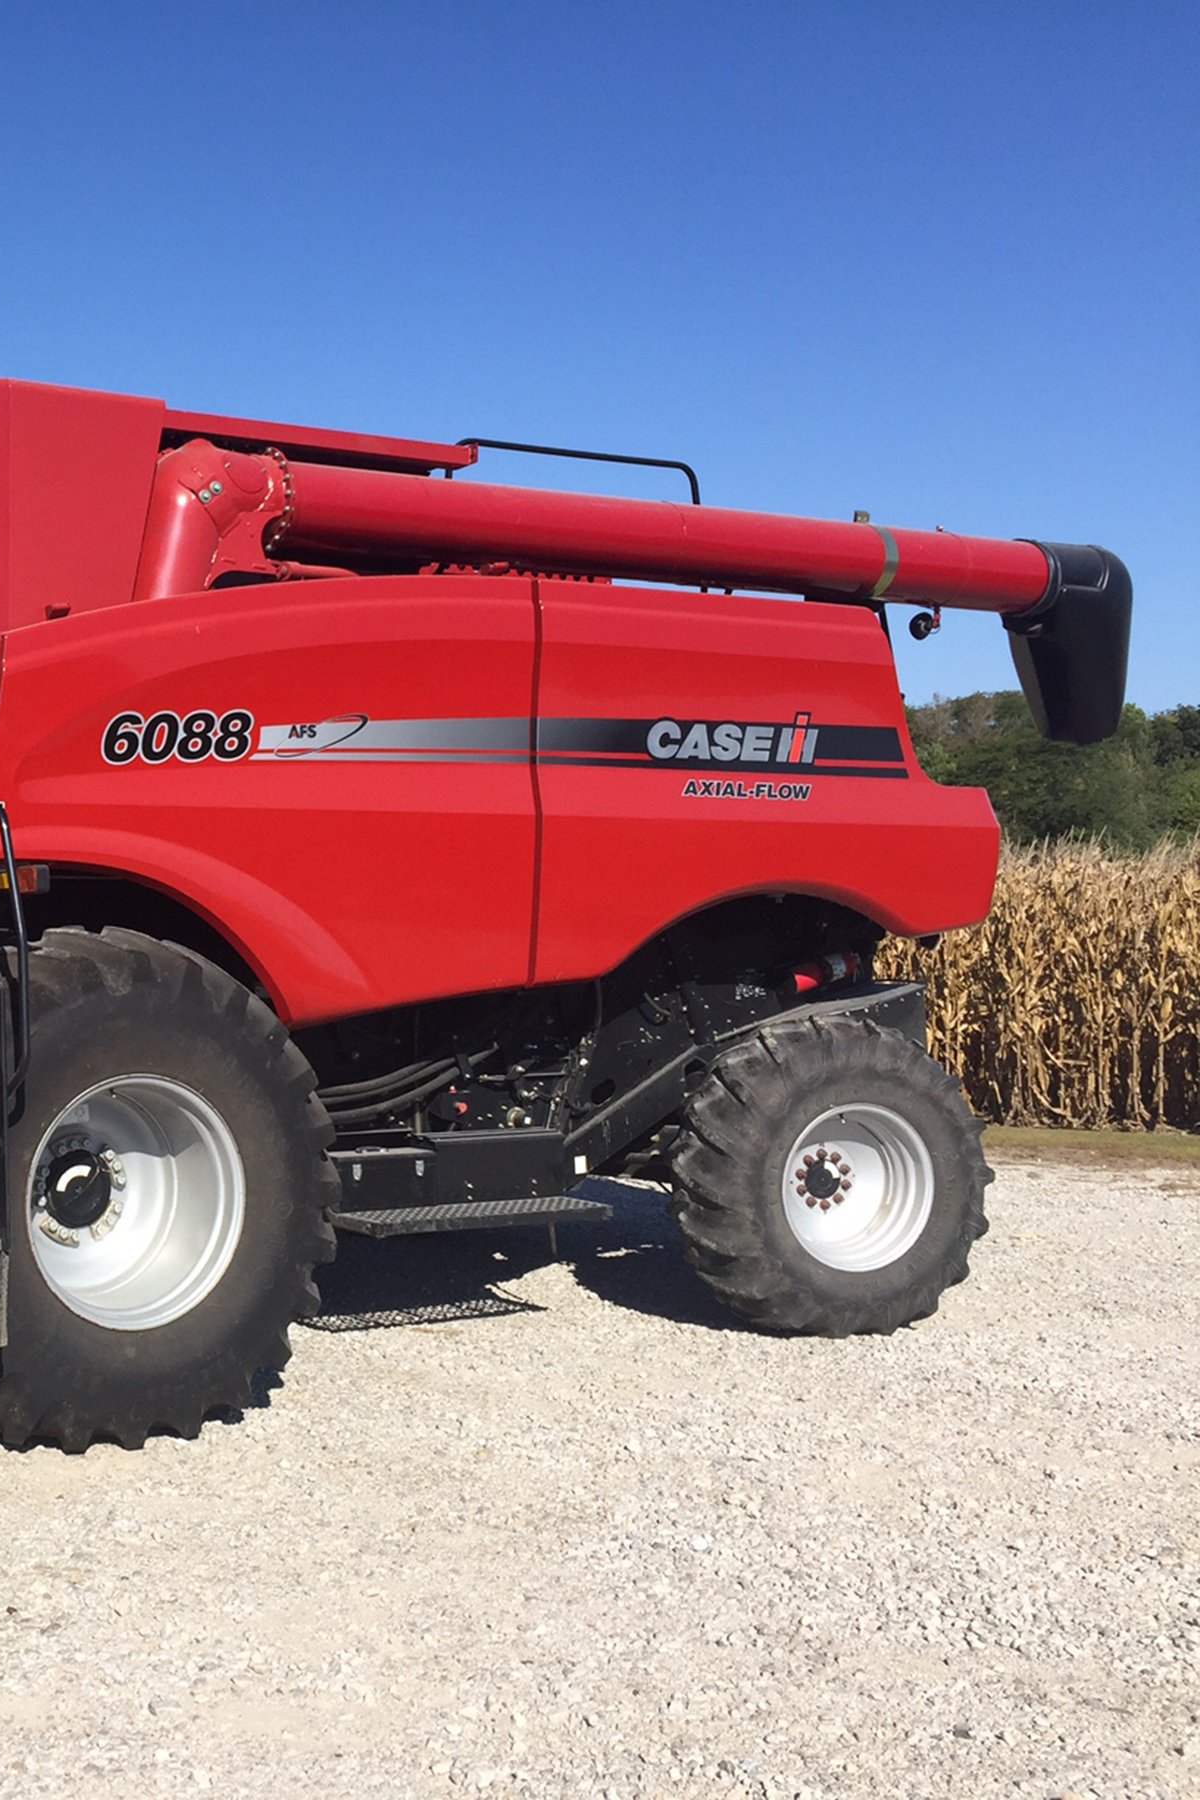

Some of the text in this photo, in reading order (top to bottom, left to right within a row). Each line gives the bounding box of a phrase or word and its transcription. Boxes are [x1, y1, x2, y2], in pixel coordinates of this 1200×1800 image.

[102, 709, 254, 764] 6088
[288, 725, 317, 739] AFS
[682, 780, 811, 800] AXIAL-FLOW
